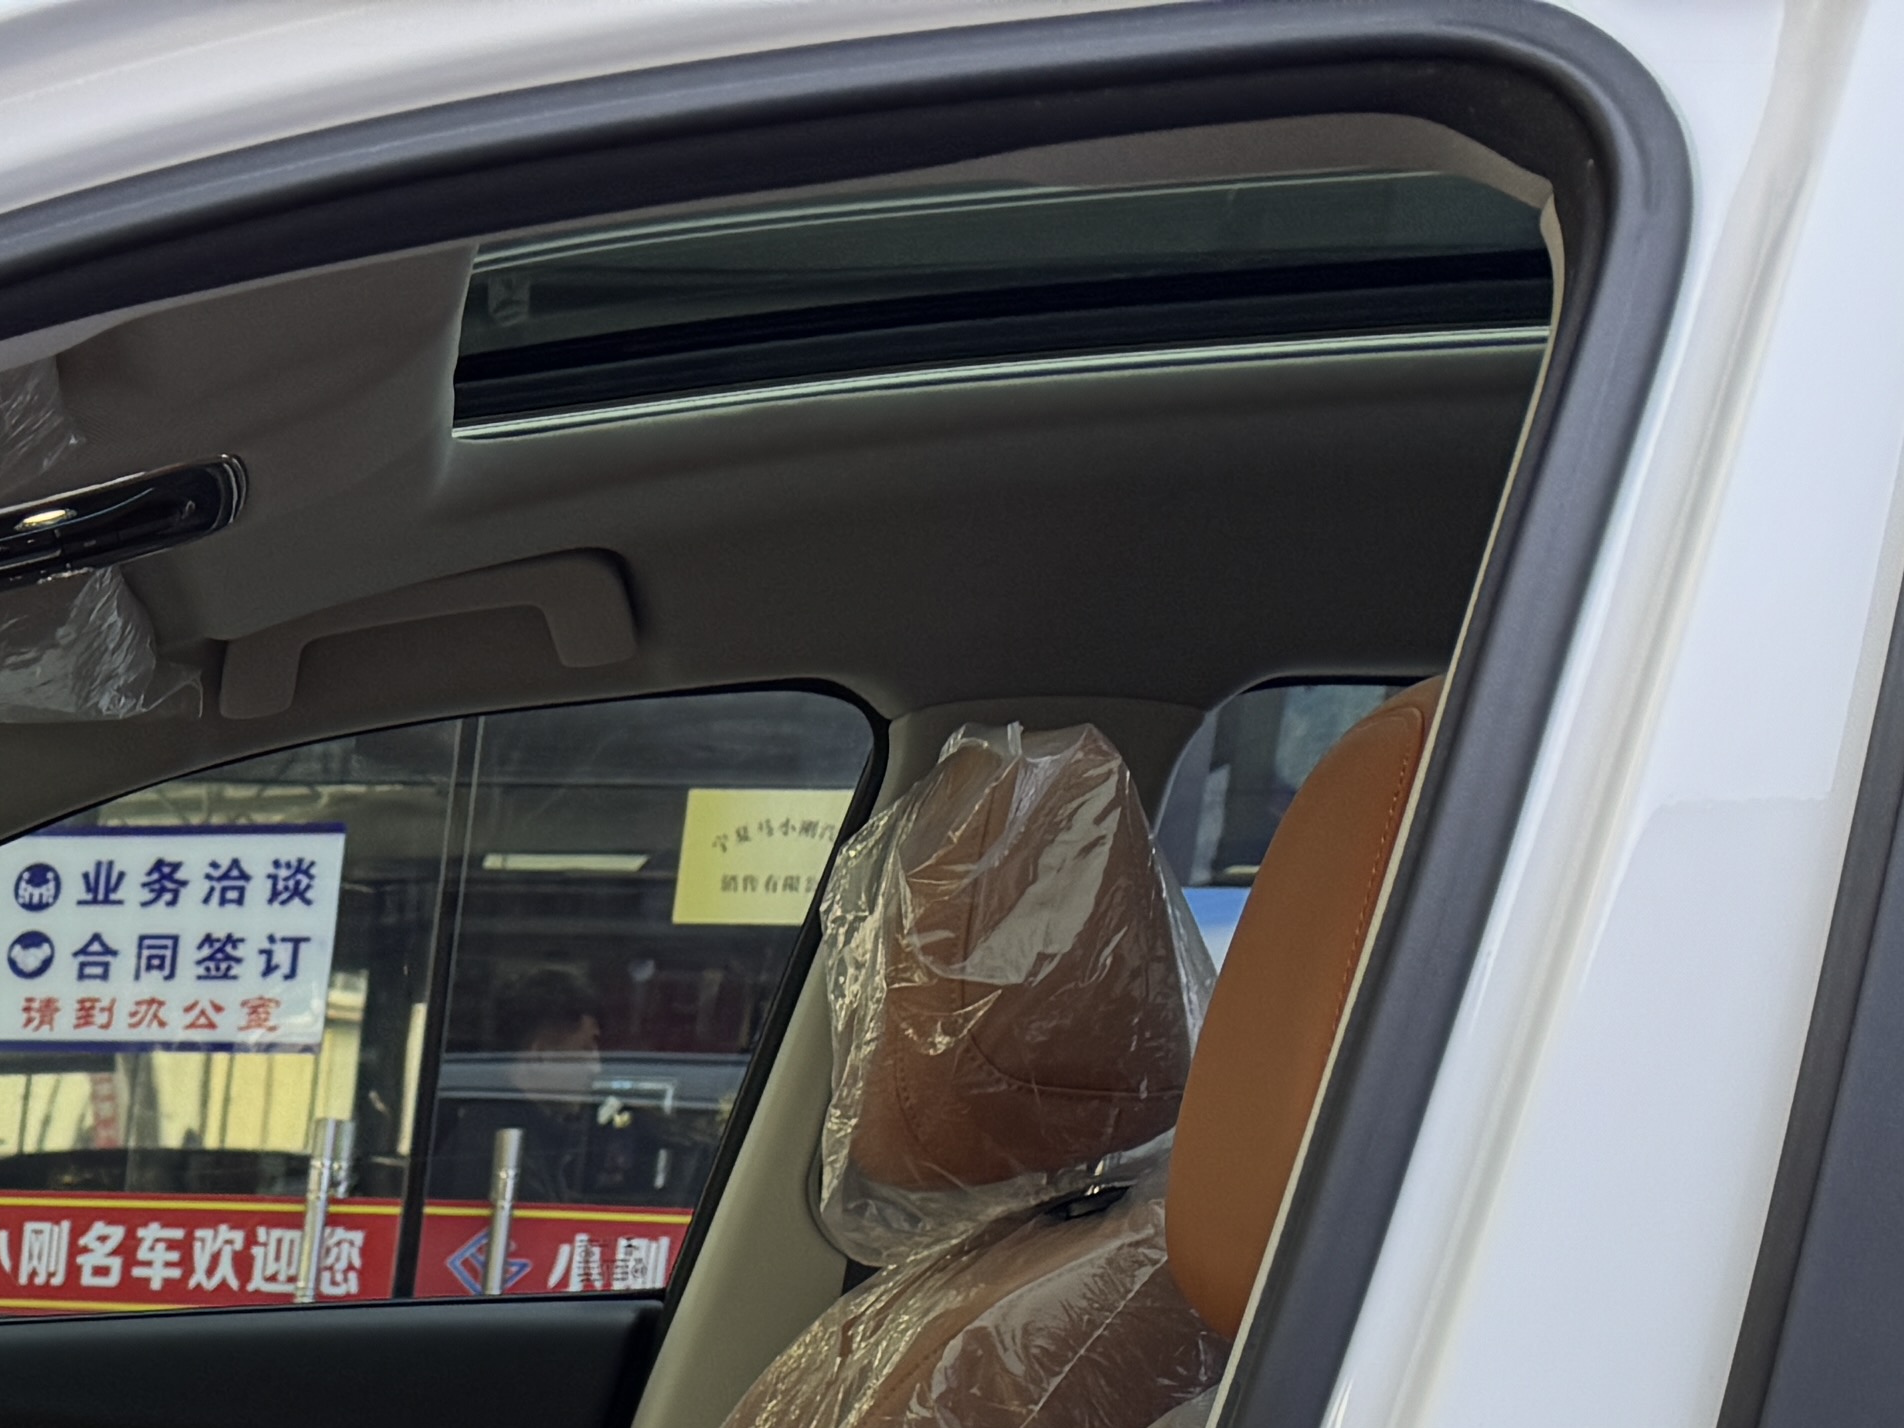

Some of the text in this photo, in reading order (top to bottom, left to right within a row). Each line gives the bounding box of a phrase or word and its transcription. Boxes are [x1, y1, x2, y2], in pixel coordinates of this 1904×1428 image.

[76, 856, 318, 908] 业务洽谈
[71, 931, 312, 982] 合同签订
[20, 994, 283, 1033] 请到办公室
[547, 1232, 672, 1293] 小刚
